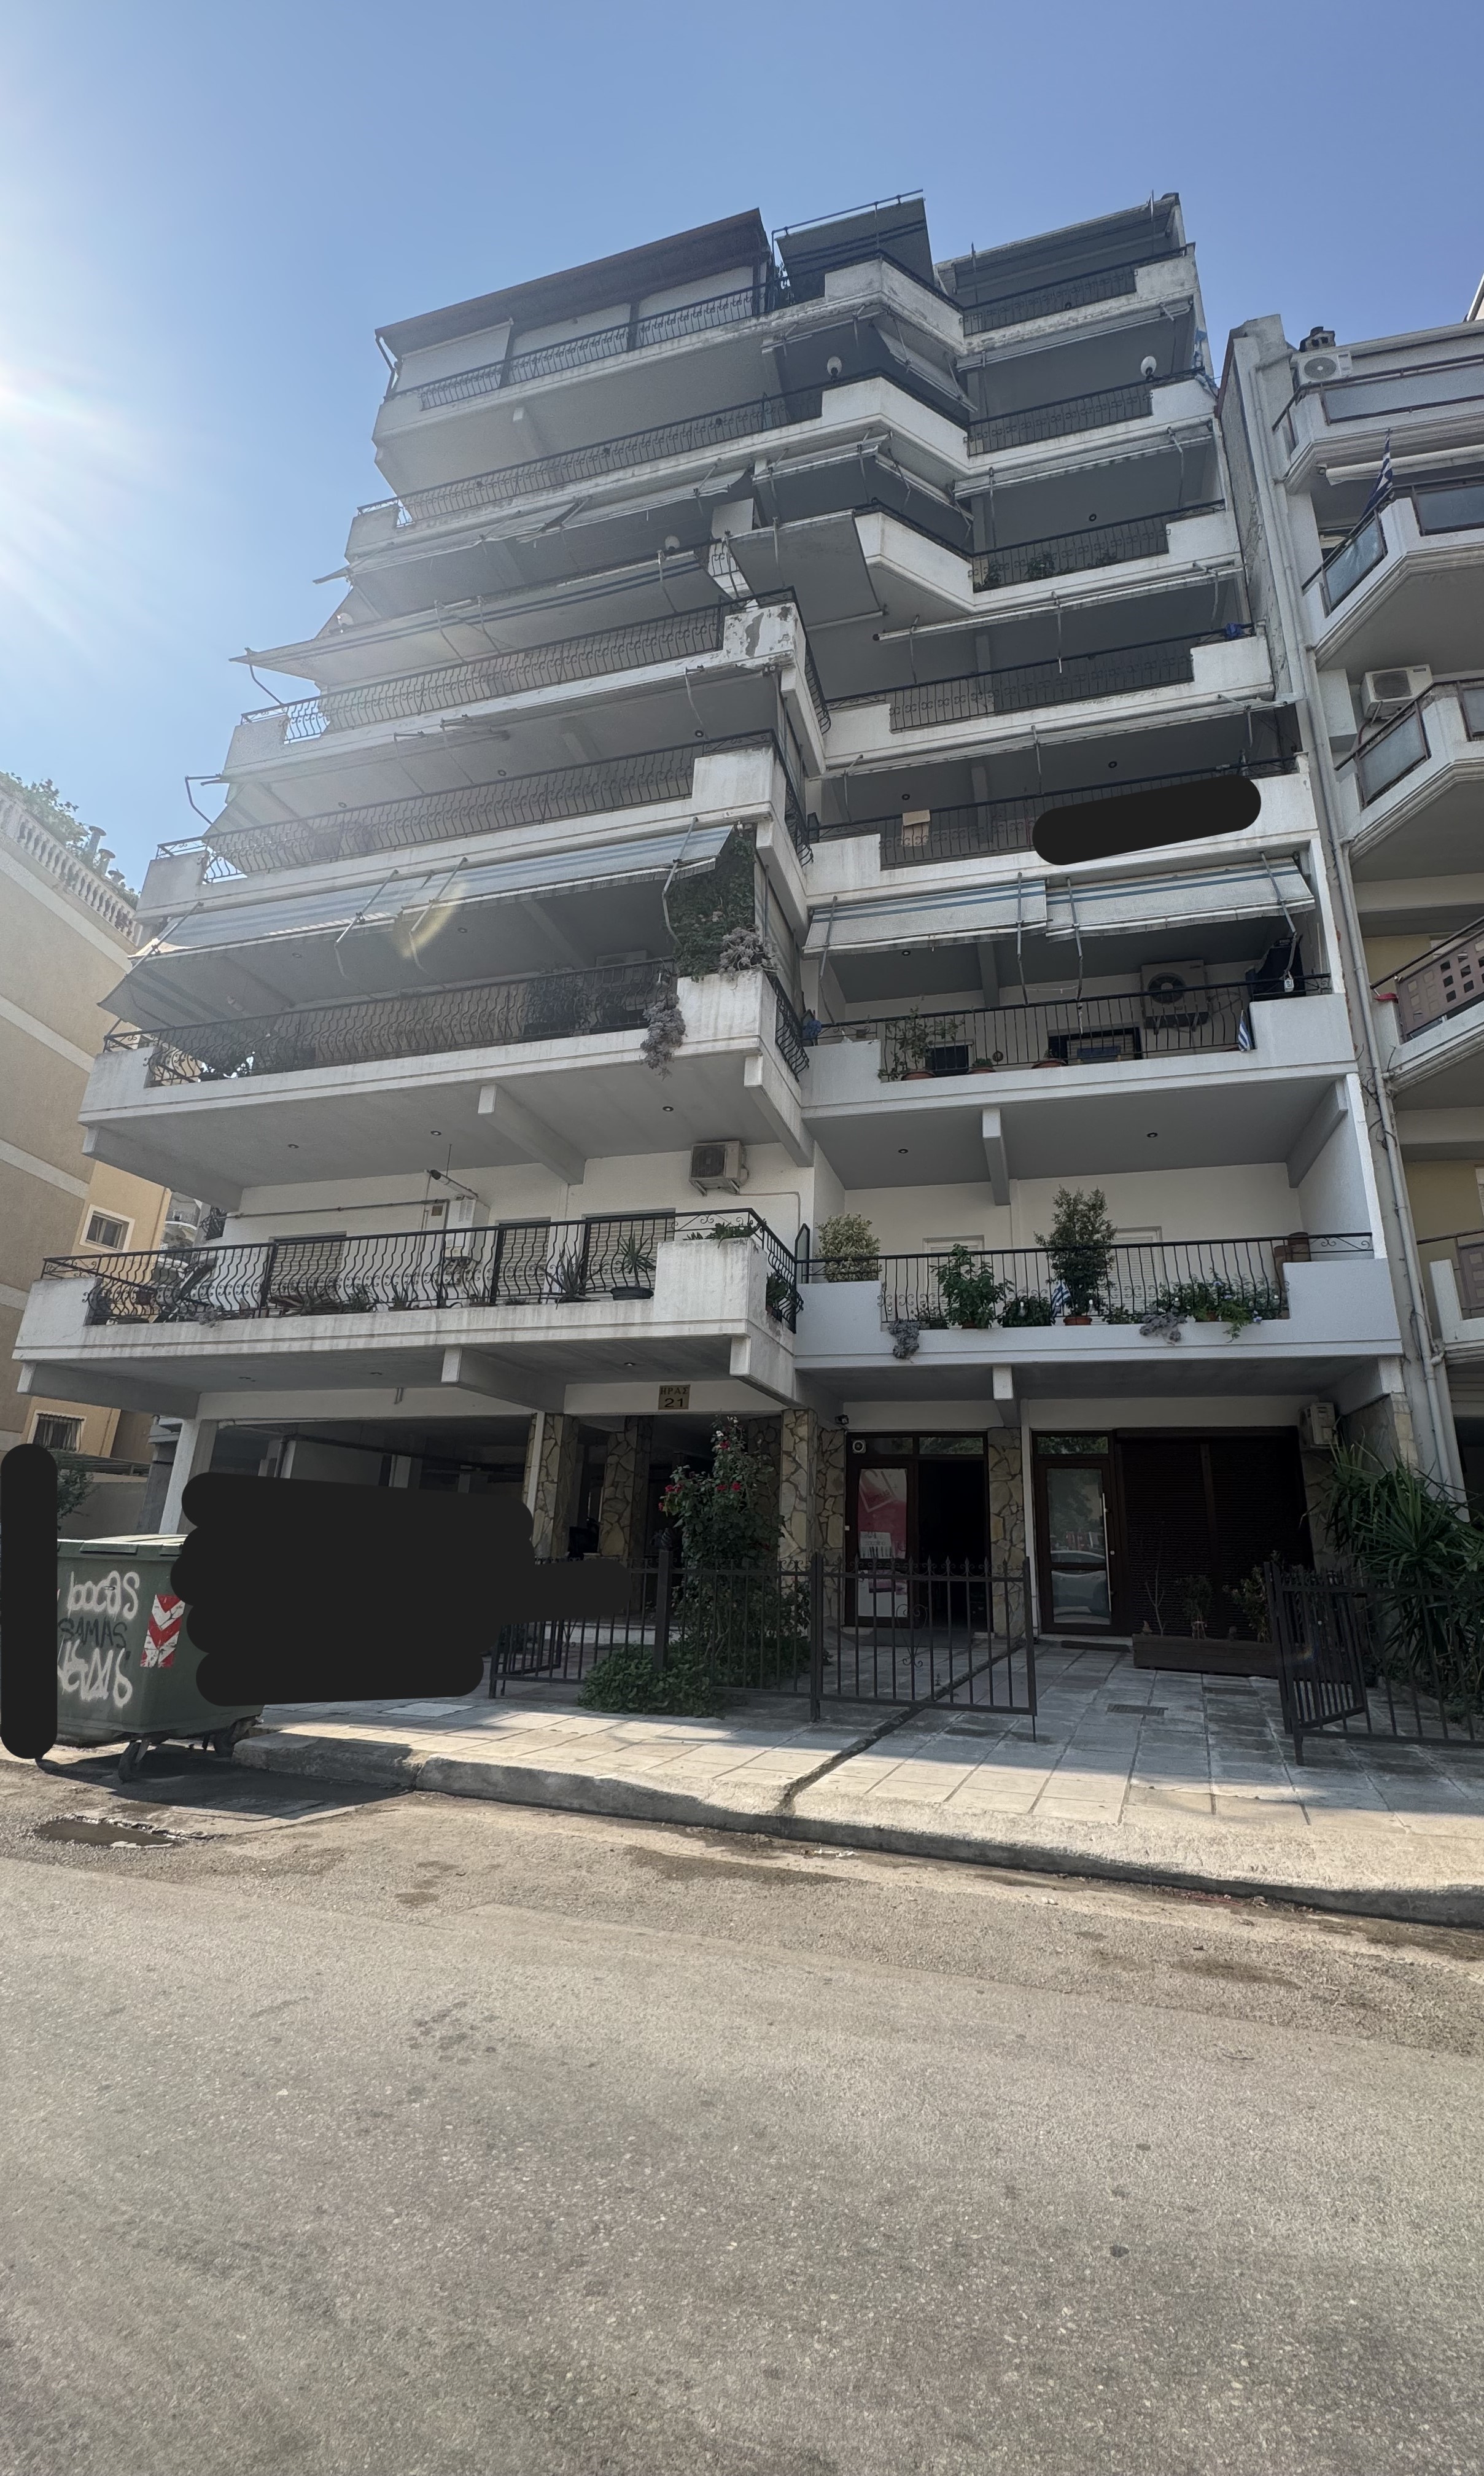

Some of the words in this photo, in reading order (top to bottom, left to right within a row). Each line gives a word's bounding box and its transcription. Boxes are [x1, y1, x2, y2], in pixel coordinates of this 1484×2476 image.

[660, 1387, 689, 1395] ΗΡΑΣ
[664, 1398, 683, 1407] 21
[58, 1616, 128, 1649] SAMAS
